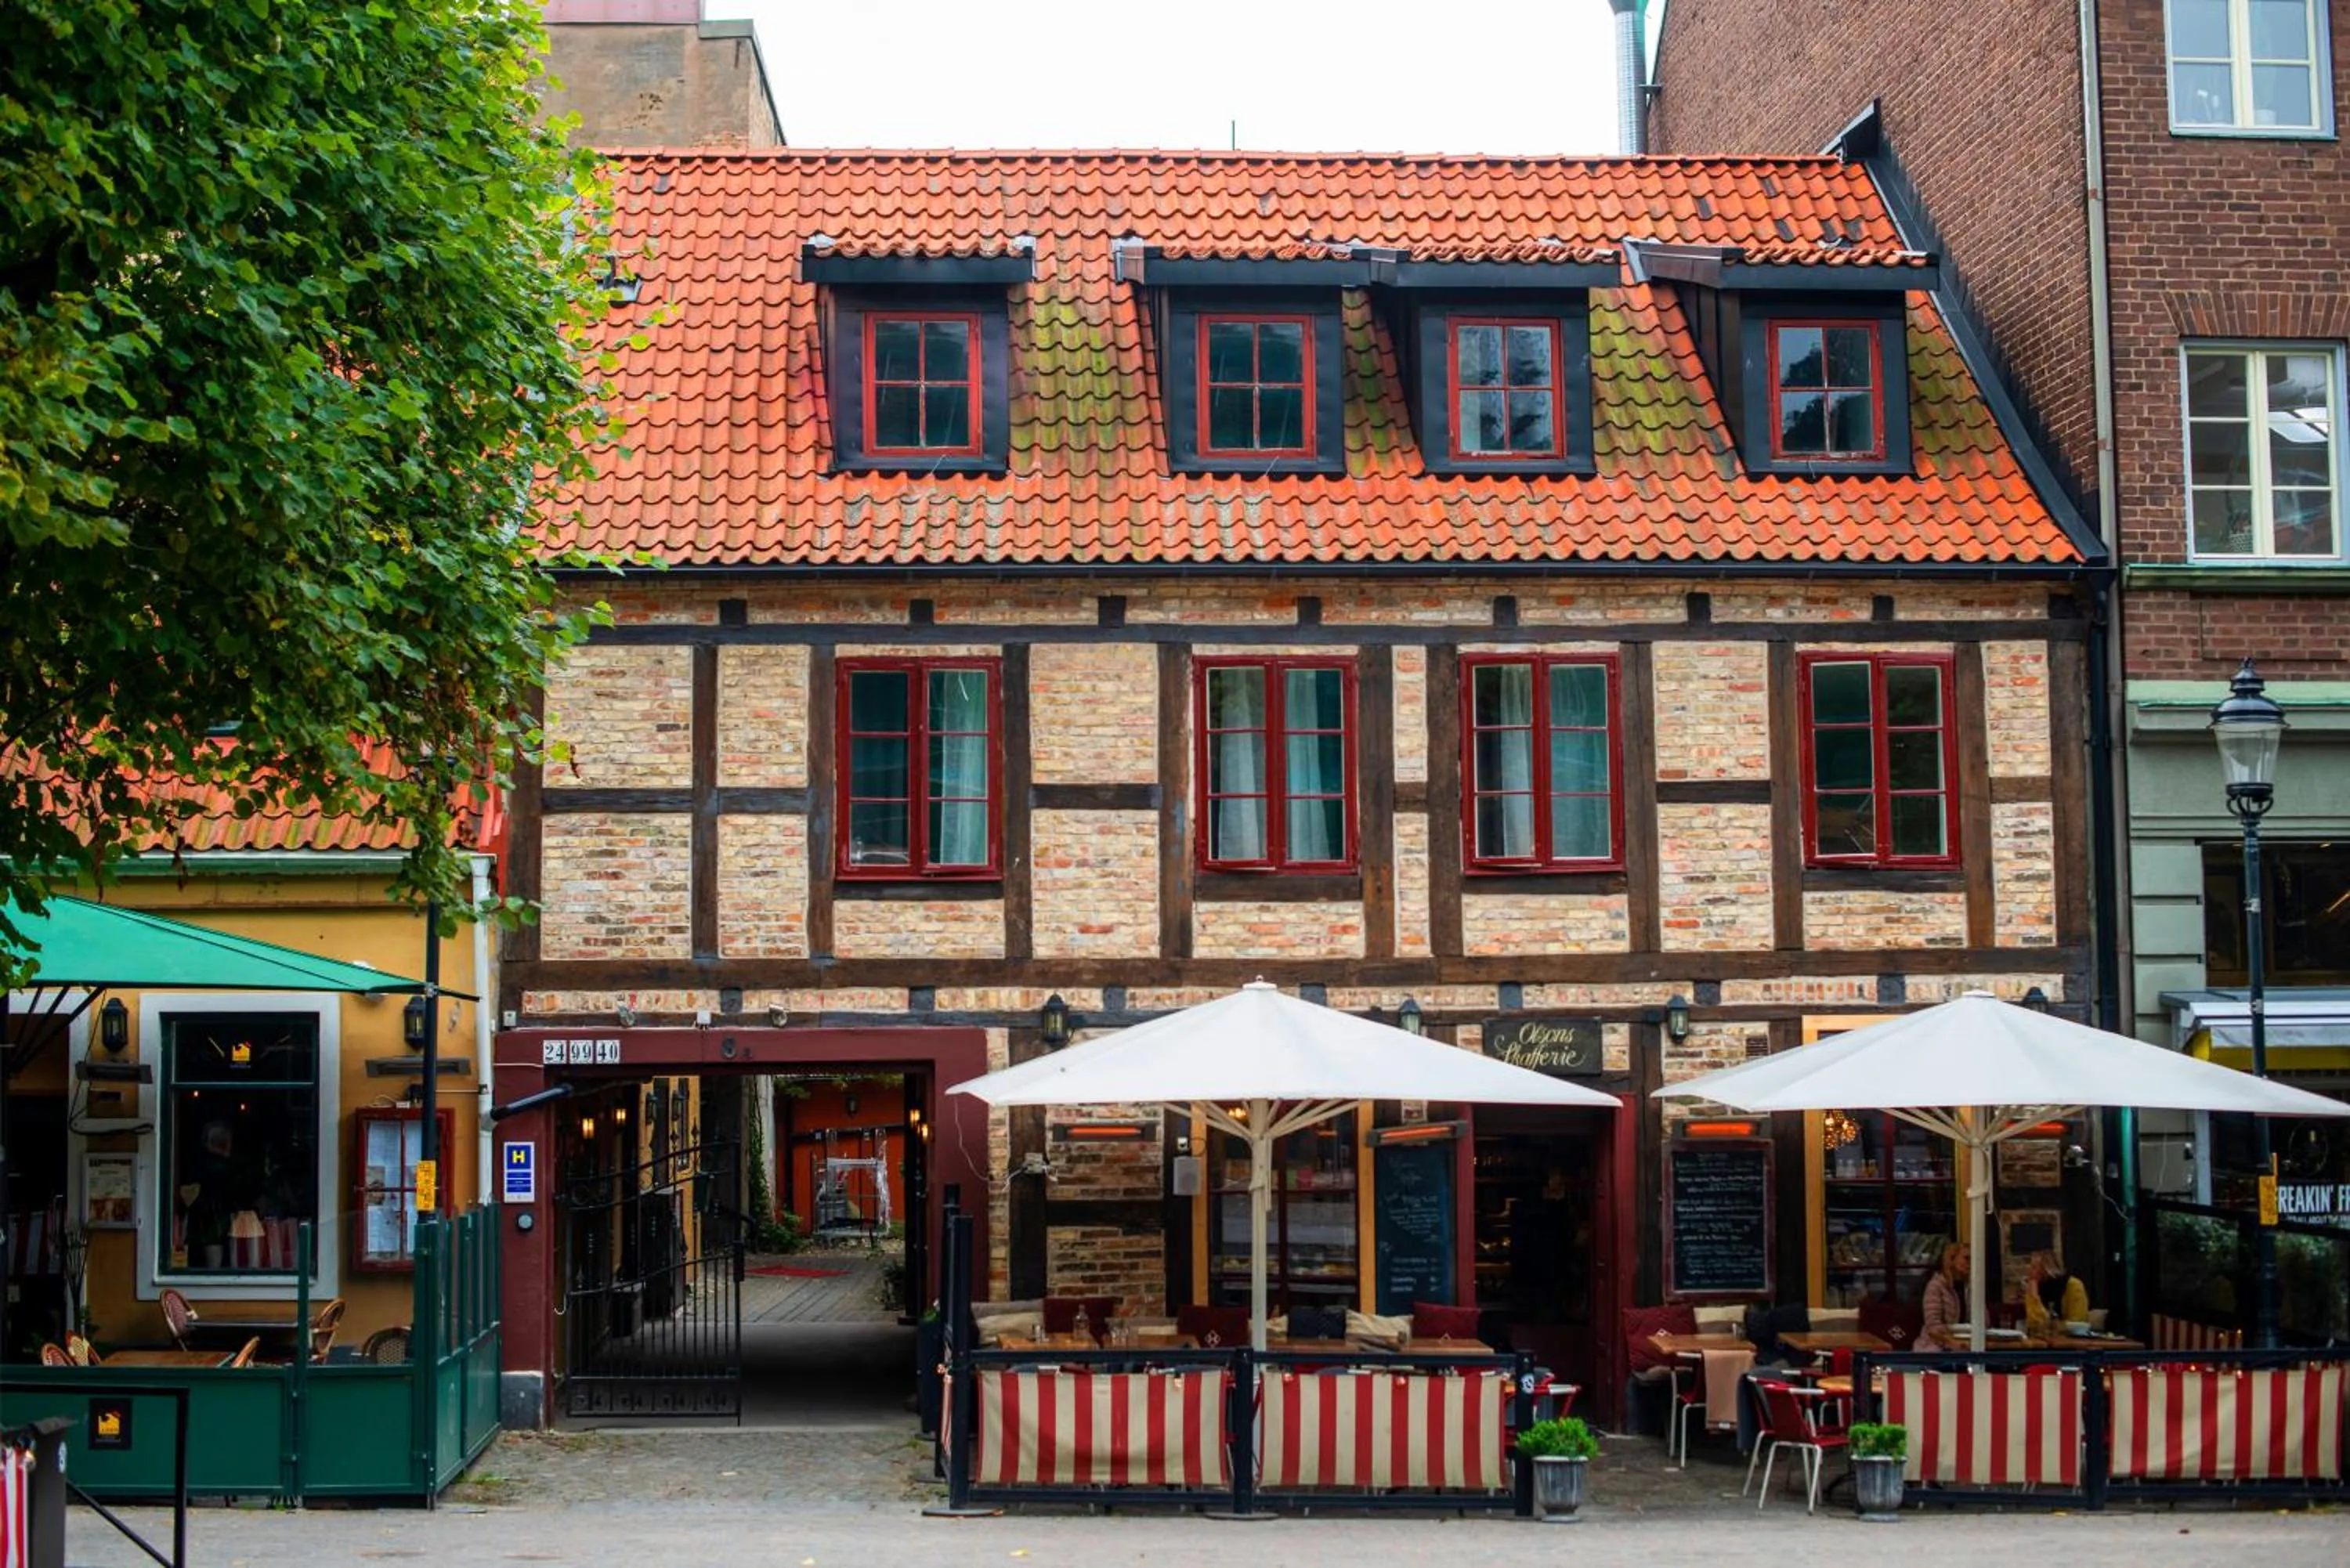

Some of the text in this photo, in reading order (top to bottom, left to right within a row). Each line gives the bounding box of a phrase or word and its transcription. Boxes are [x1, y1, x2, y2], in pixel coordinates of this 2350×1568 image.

[1518, 1021, 1576, 1045] Olsons
[544, 1042, 618, 1061] 24 99 40
[512, 1150, 526, 1165] H
[2274, 1184, 2334, 1213] REAKIN'
